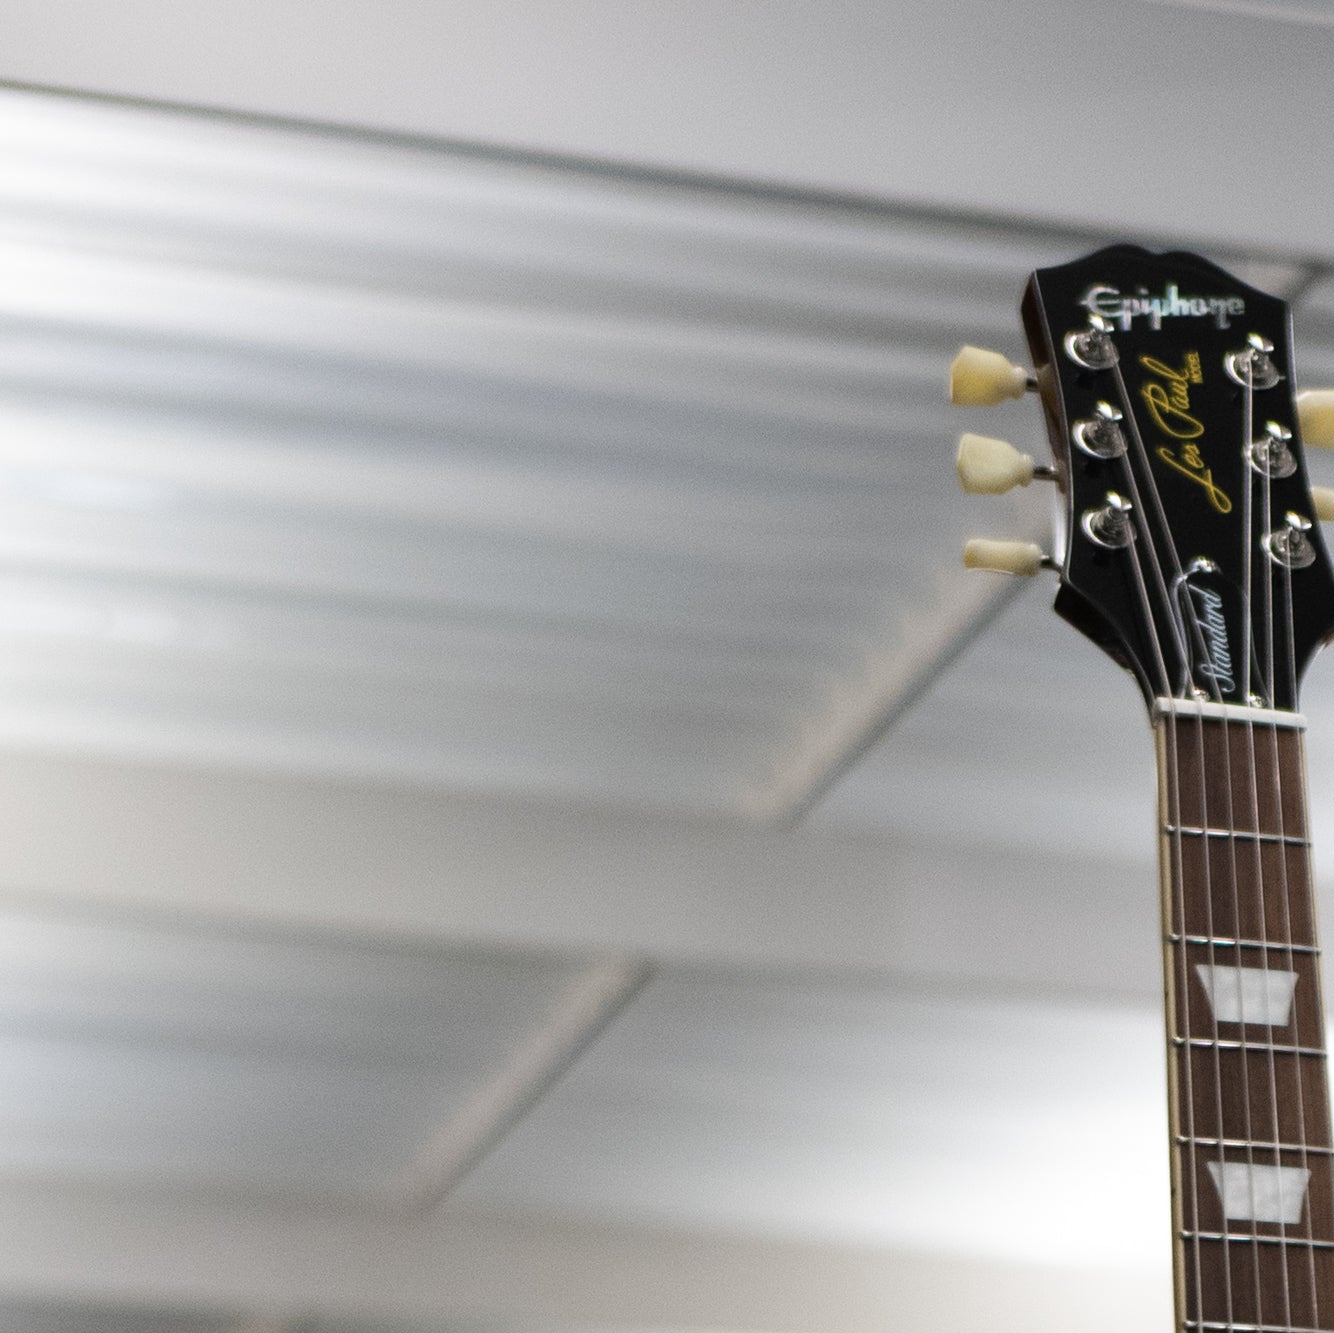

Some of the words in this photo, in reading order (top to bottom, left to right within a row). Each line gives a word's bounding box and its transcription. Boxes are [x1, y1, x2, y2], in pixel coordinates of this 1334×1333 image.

[1080, 284, 1245, 331] Epiphone
[1141, 356, 1205, 439] Paul
[1158, 443, 1233, 514] Les
[1187, 583, 1236, 693] Standard
